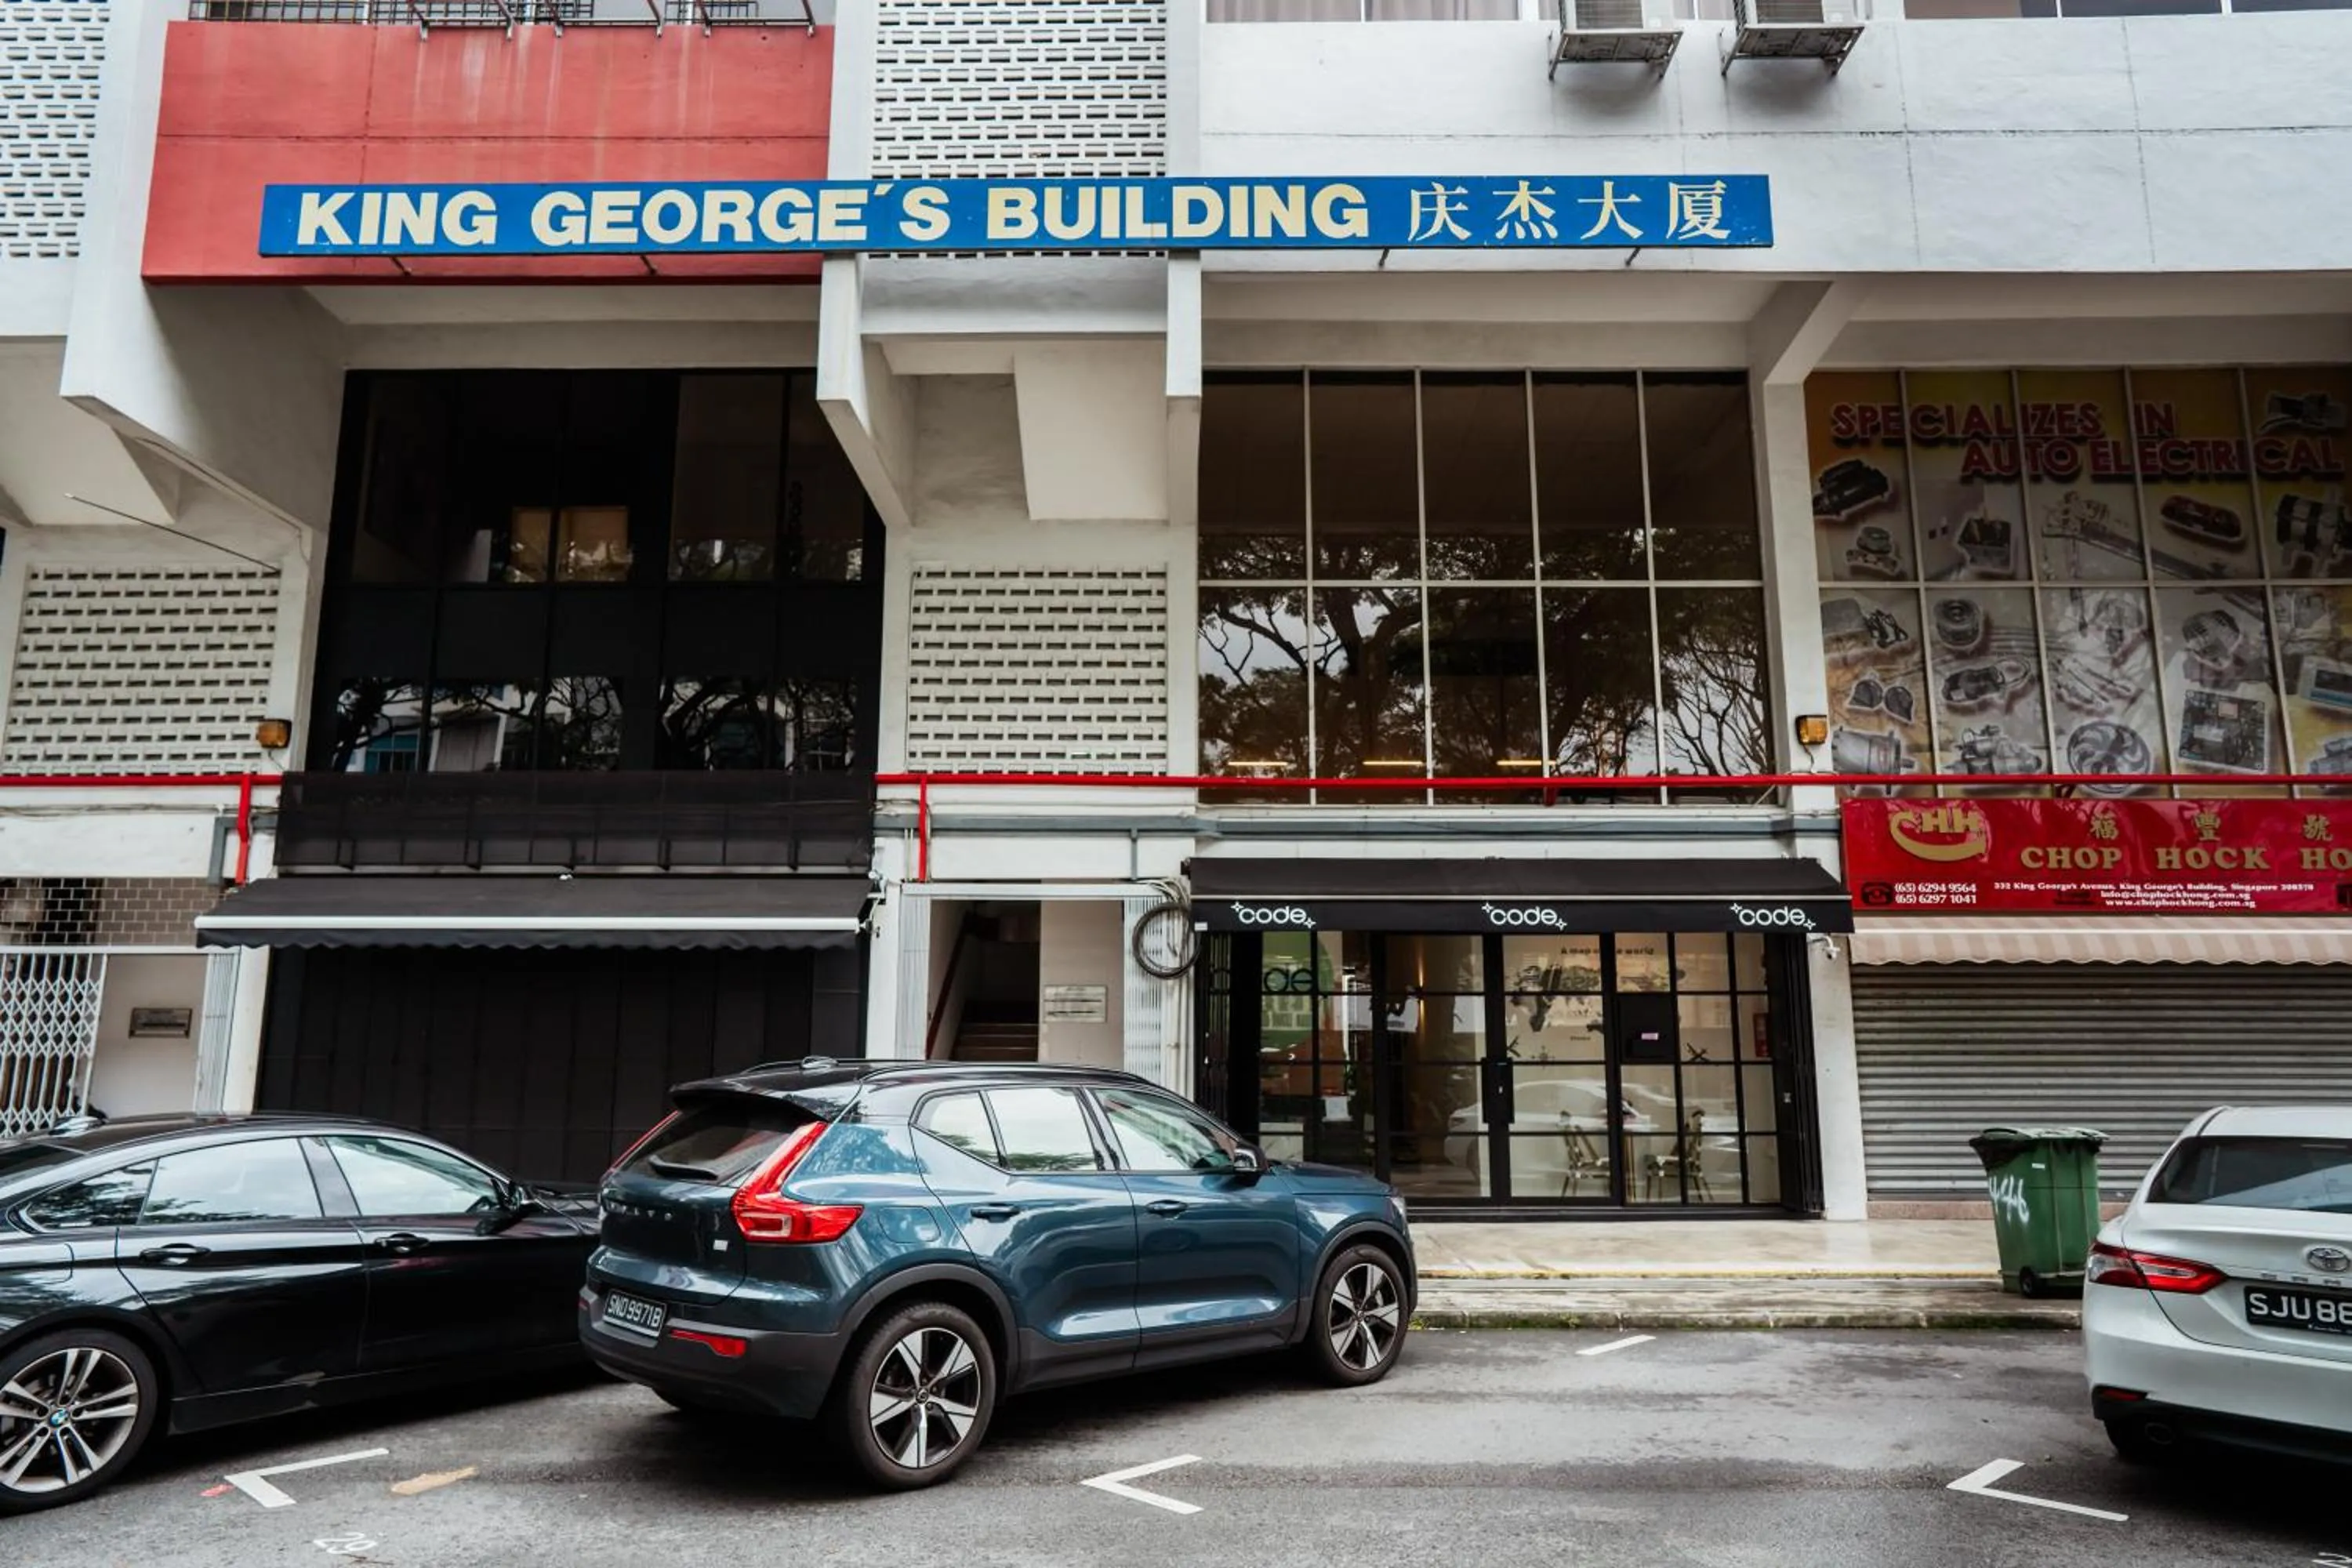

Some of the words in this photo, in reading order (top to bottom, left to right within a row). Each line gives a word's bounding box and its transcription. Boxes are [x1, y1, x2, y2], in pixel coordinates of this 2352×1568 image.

[296, 191, 499, 246] KING
[986, 183, 1370, 240] BUILDING
[1408, 180, 1731, 242] 庆杰大厦
[1833, 403, 2103, 437] SPECIALIZES
[2134, 402, 2175, 434] IN
[1962, 440, 2078, 474] AUTO
[2089, 437, 2342, 472] ELECTRICAL
[2020, 847, 2122, 869] CHOP
[2156, 847, 2270, 869] HOCK
[2300, 847, 2352, 869] HO
[1894, 882, 1916, 892] (65)
[1918, 882, 1947, 892] 6294
[1948, 882, 1976, 892] 9564
[2013, 882, 2035, 891] King
[1895, 894, 1917, 904] (65)
[1918, 894, 1947, 904] 6297
[1950, 894, 1976, 904] 1041
[1239, 905, 1307, 924] code
[1490, 906, 1558, 925] code
[1739, 906, 1806, 925] code
